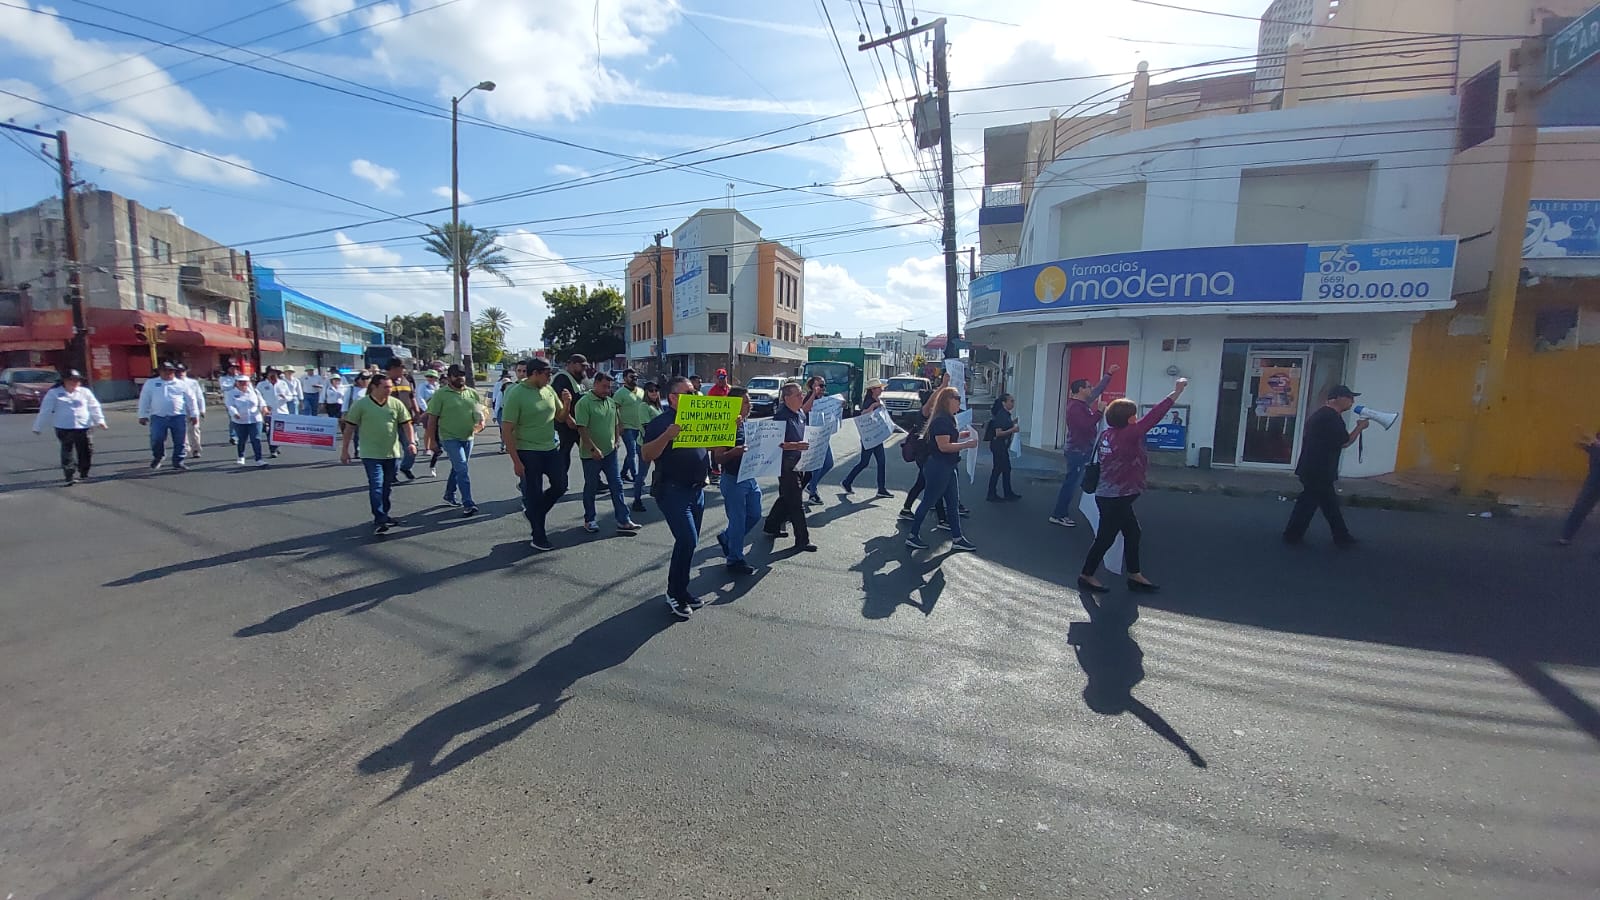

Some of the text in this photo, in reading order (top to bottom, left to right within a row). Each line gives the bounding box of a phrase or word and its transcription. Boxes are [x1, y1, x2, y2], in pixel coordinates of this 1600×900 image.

[1529, 202, 1568, 211] ALLER
[1371, 246, 1428, 257] Servicio
[1379, 255, 1440, 266] Domicilio
[1071, 260, 1139, 276] farmacias
[1070, 268, 1235, 301] moderna
[1320, 275, 1345, 284] (669)
[1318, 281, 1430, 299] 980.00.00
[690, 399, 730, 409] RESPETO AL
[680, 411, 731, 420] CUMPLIMIENTO
[680, 423, 693, 432] DEL
[711, 433, 735, 442] TRABAJO
